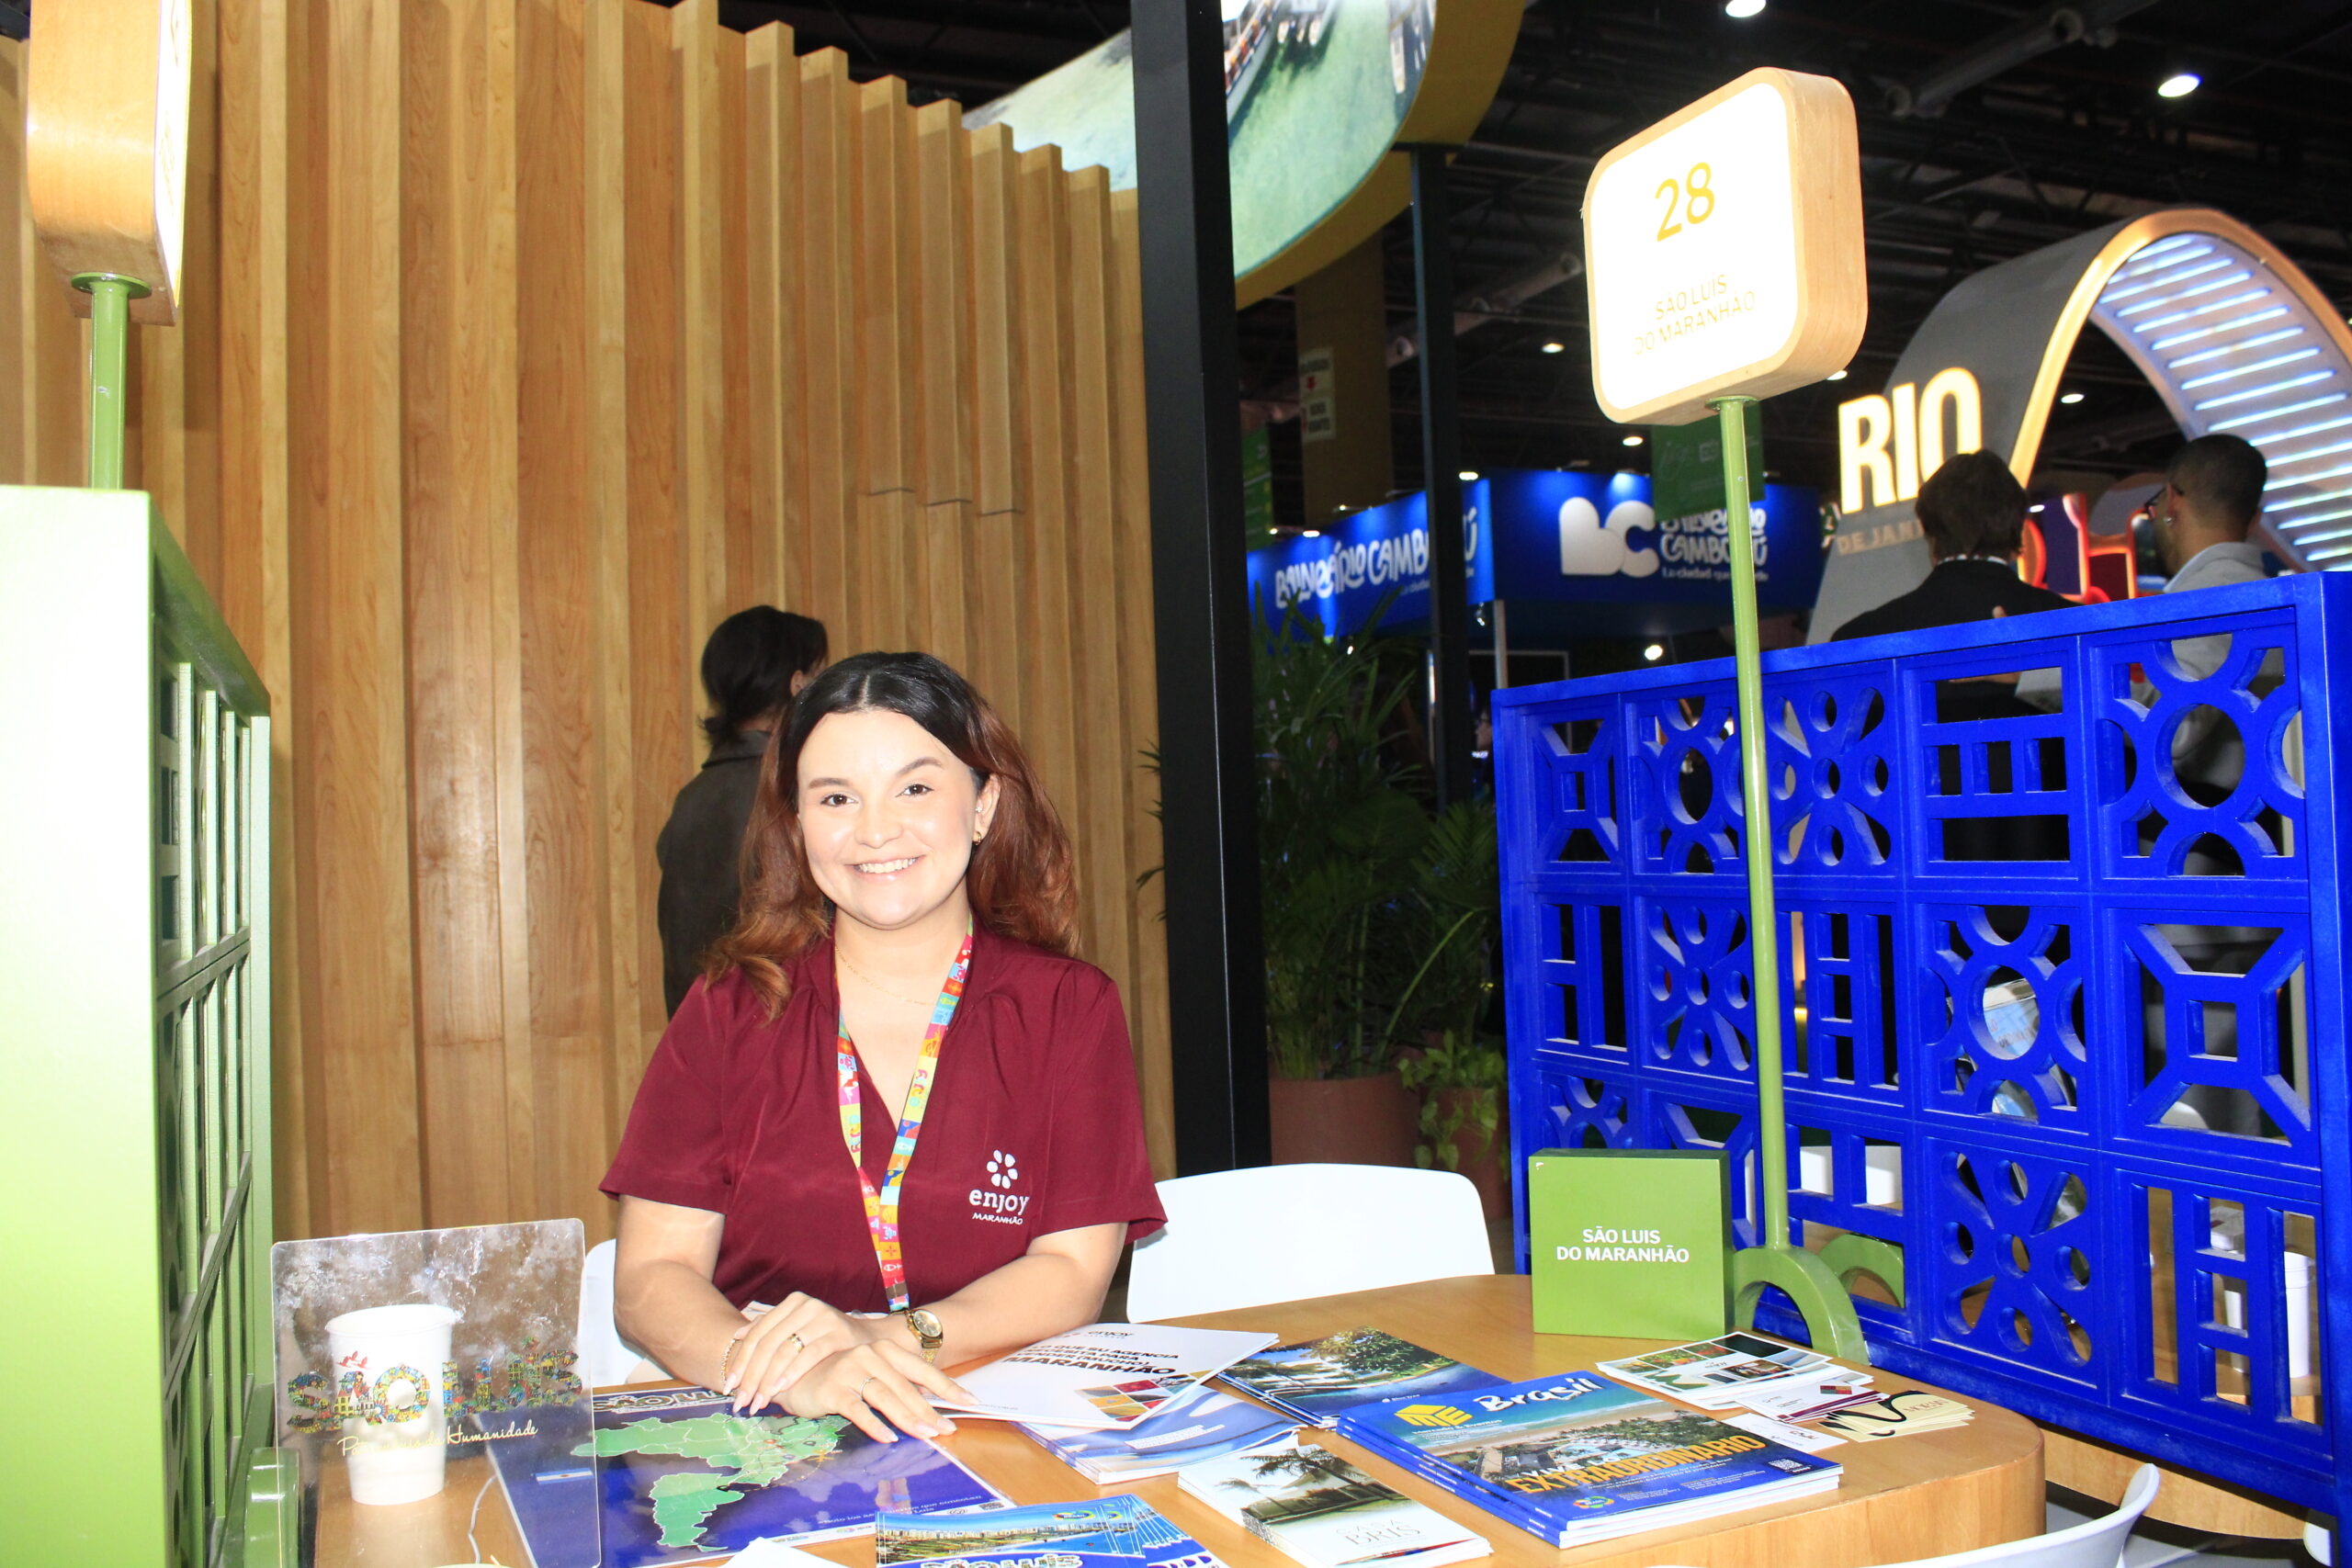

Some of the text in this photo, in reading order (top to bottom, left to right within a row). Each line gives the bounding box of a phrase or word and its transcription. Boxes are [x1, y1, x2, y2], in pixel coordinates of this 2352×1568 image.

[1655, 162, 1715, 242] 28
[1634, 331, 1657, 355] DO
[1838, 367, 1983, 514] RIO
[1838, 530, 1866, 556] DE
[968, 1189, 1030, 1216] enjoy
[972, 1213, 1023, 1225] MARANHÃO
[1582, 1225, 1661, 1245] SÃO LUIS
[1556, 1245, 1690, 1263] DO MARANHÃO
[1002, 1356, 1177, 1375] MARANHÃO
[1473, 1377, 1606, 1412] Brasil
[447, 1419, 538, 1444] Humanidade
[1505, 1435, 1768, 1495] EXTRAORDINARIO
[1344, 1524, 1421, 1546] BRIS
